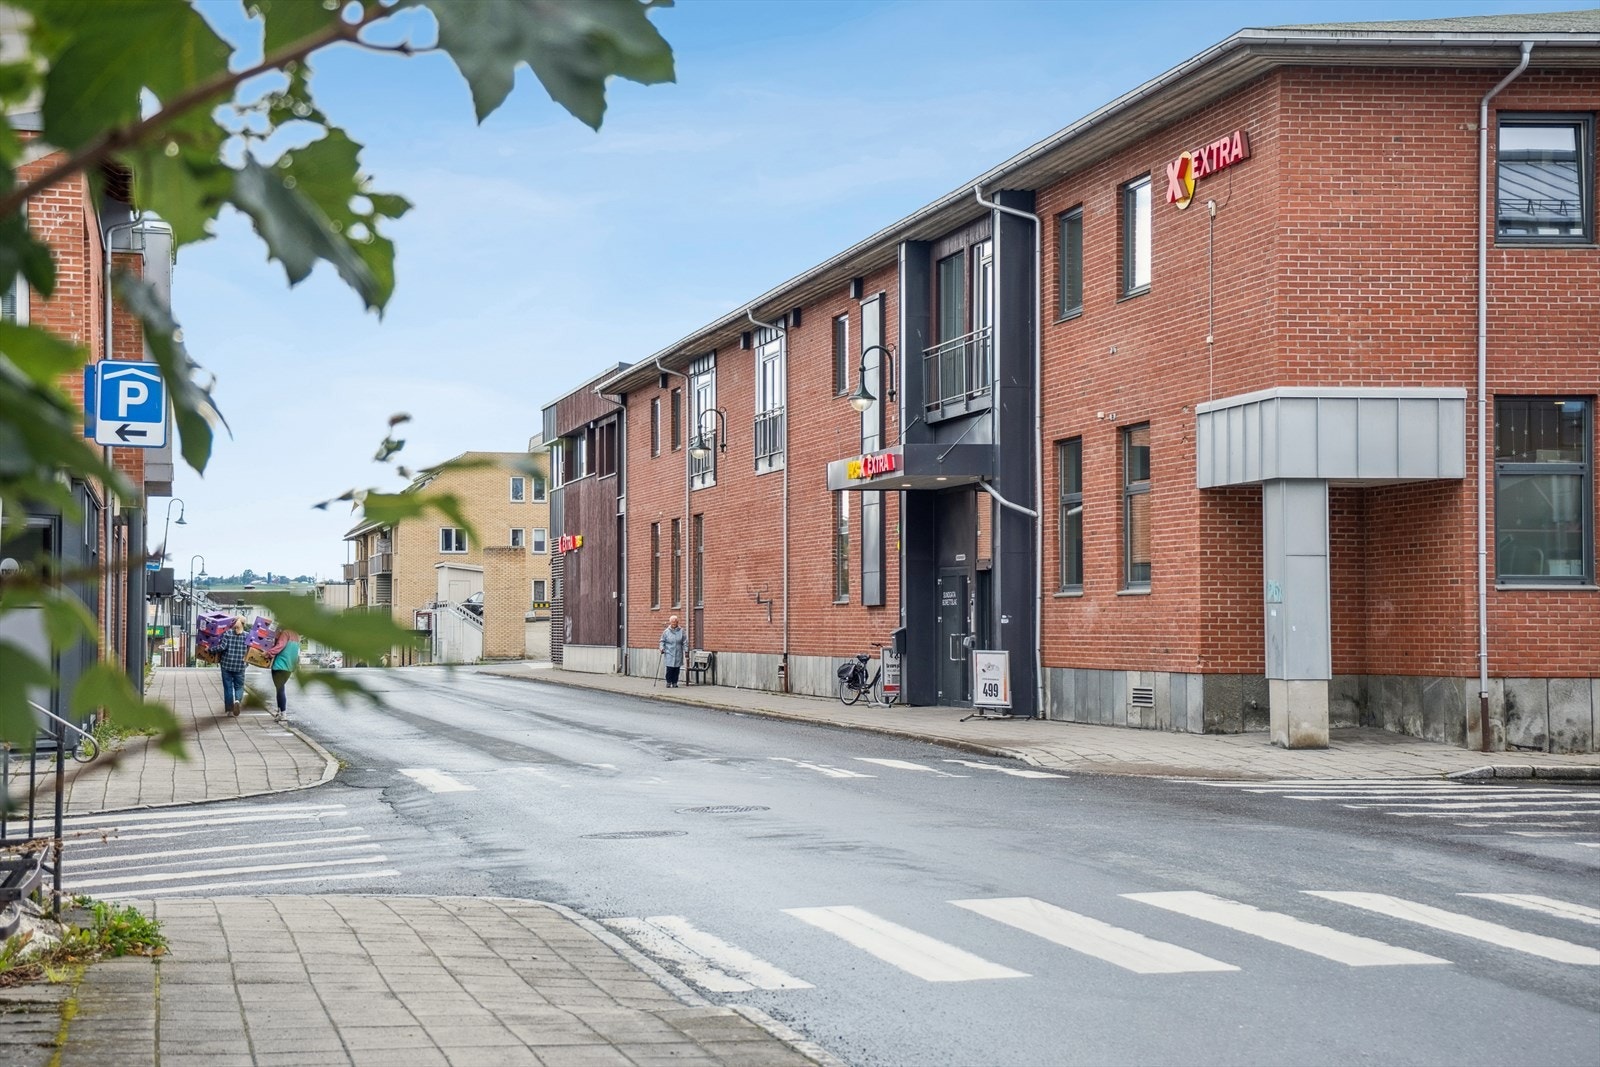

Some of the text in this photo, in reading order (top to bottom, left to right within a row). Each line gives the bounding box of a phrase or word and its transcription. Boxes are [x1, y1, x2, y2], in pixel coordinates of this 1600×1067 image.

[1191, 130, 1243, 180] EXTRA
[118, 380, 149, 418] P
[867, 454, 889, 474] EXTRA
[983, 682, 999, 698] 499
